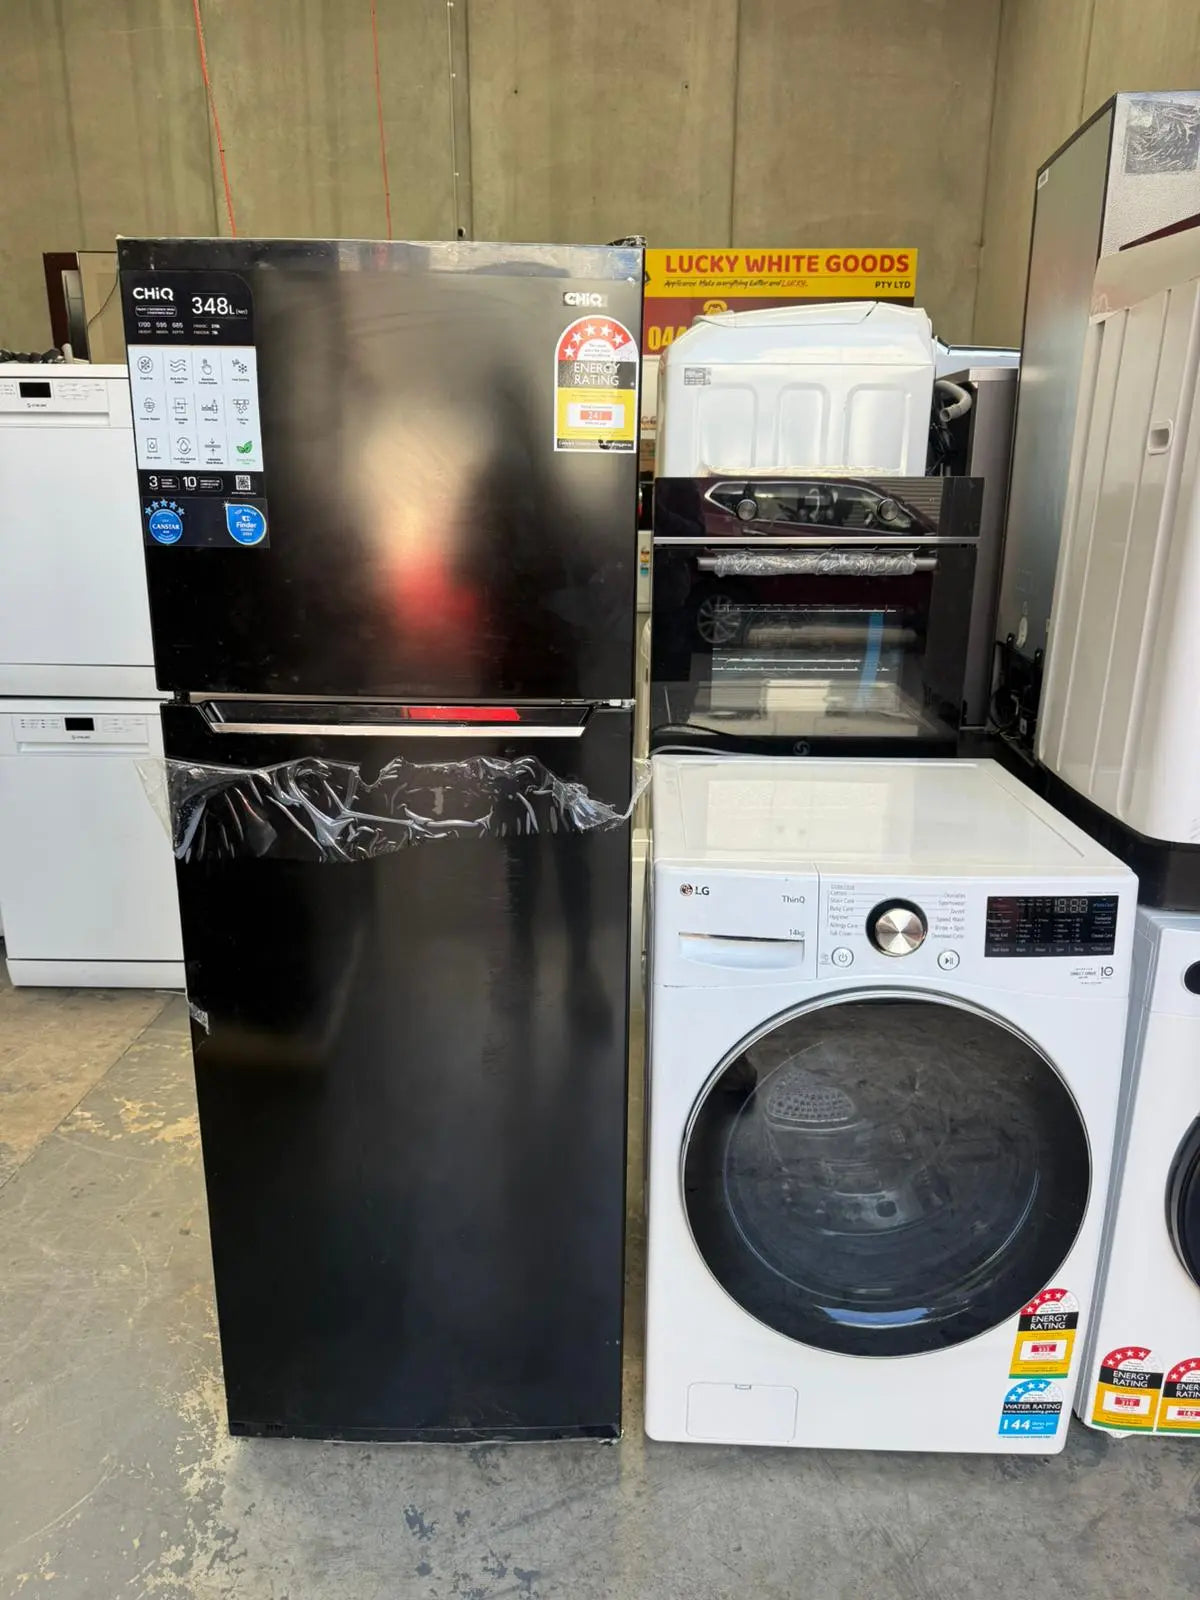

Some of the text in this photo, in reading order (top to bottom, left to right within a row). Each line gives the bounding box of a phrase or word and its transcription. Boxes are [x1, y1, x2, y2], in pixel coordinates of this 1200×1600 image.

[665, 254, 909, 273] LUCKY WHITE GOODS
[875, 281, 892, 289] PTY
[133, 287, 174, 301] CHiQ
[574, 362, 620, 374] ENERGY
[574, 374, 619, 386] RATING
[149, 475, 158, 487] 3
[183, 476, 197, 488] 10
[695, 886, 710, 896] LG
[782, 895, 805, 904] ThinQ
[789, 929, 805, 938] 14kg
[1031, 1314, 1068, 1323] ENERGY
[1030, 1322, 1066, 1330] RATING
[1113, 1370, 1150, 1381] ENERGY
[1112, 1378, 1148, 1388] RATING
[1176, 1383, 1200, 1391] ENER
[1002, 1418, 1031, 1431] 144
